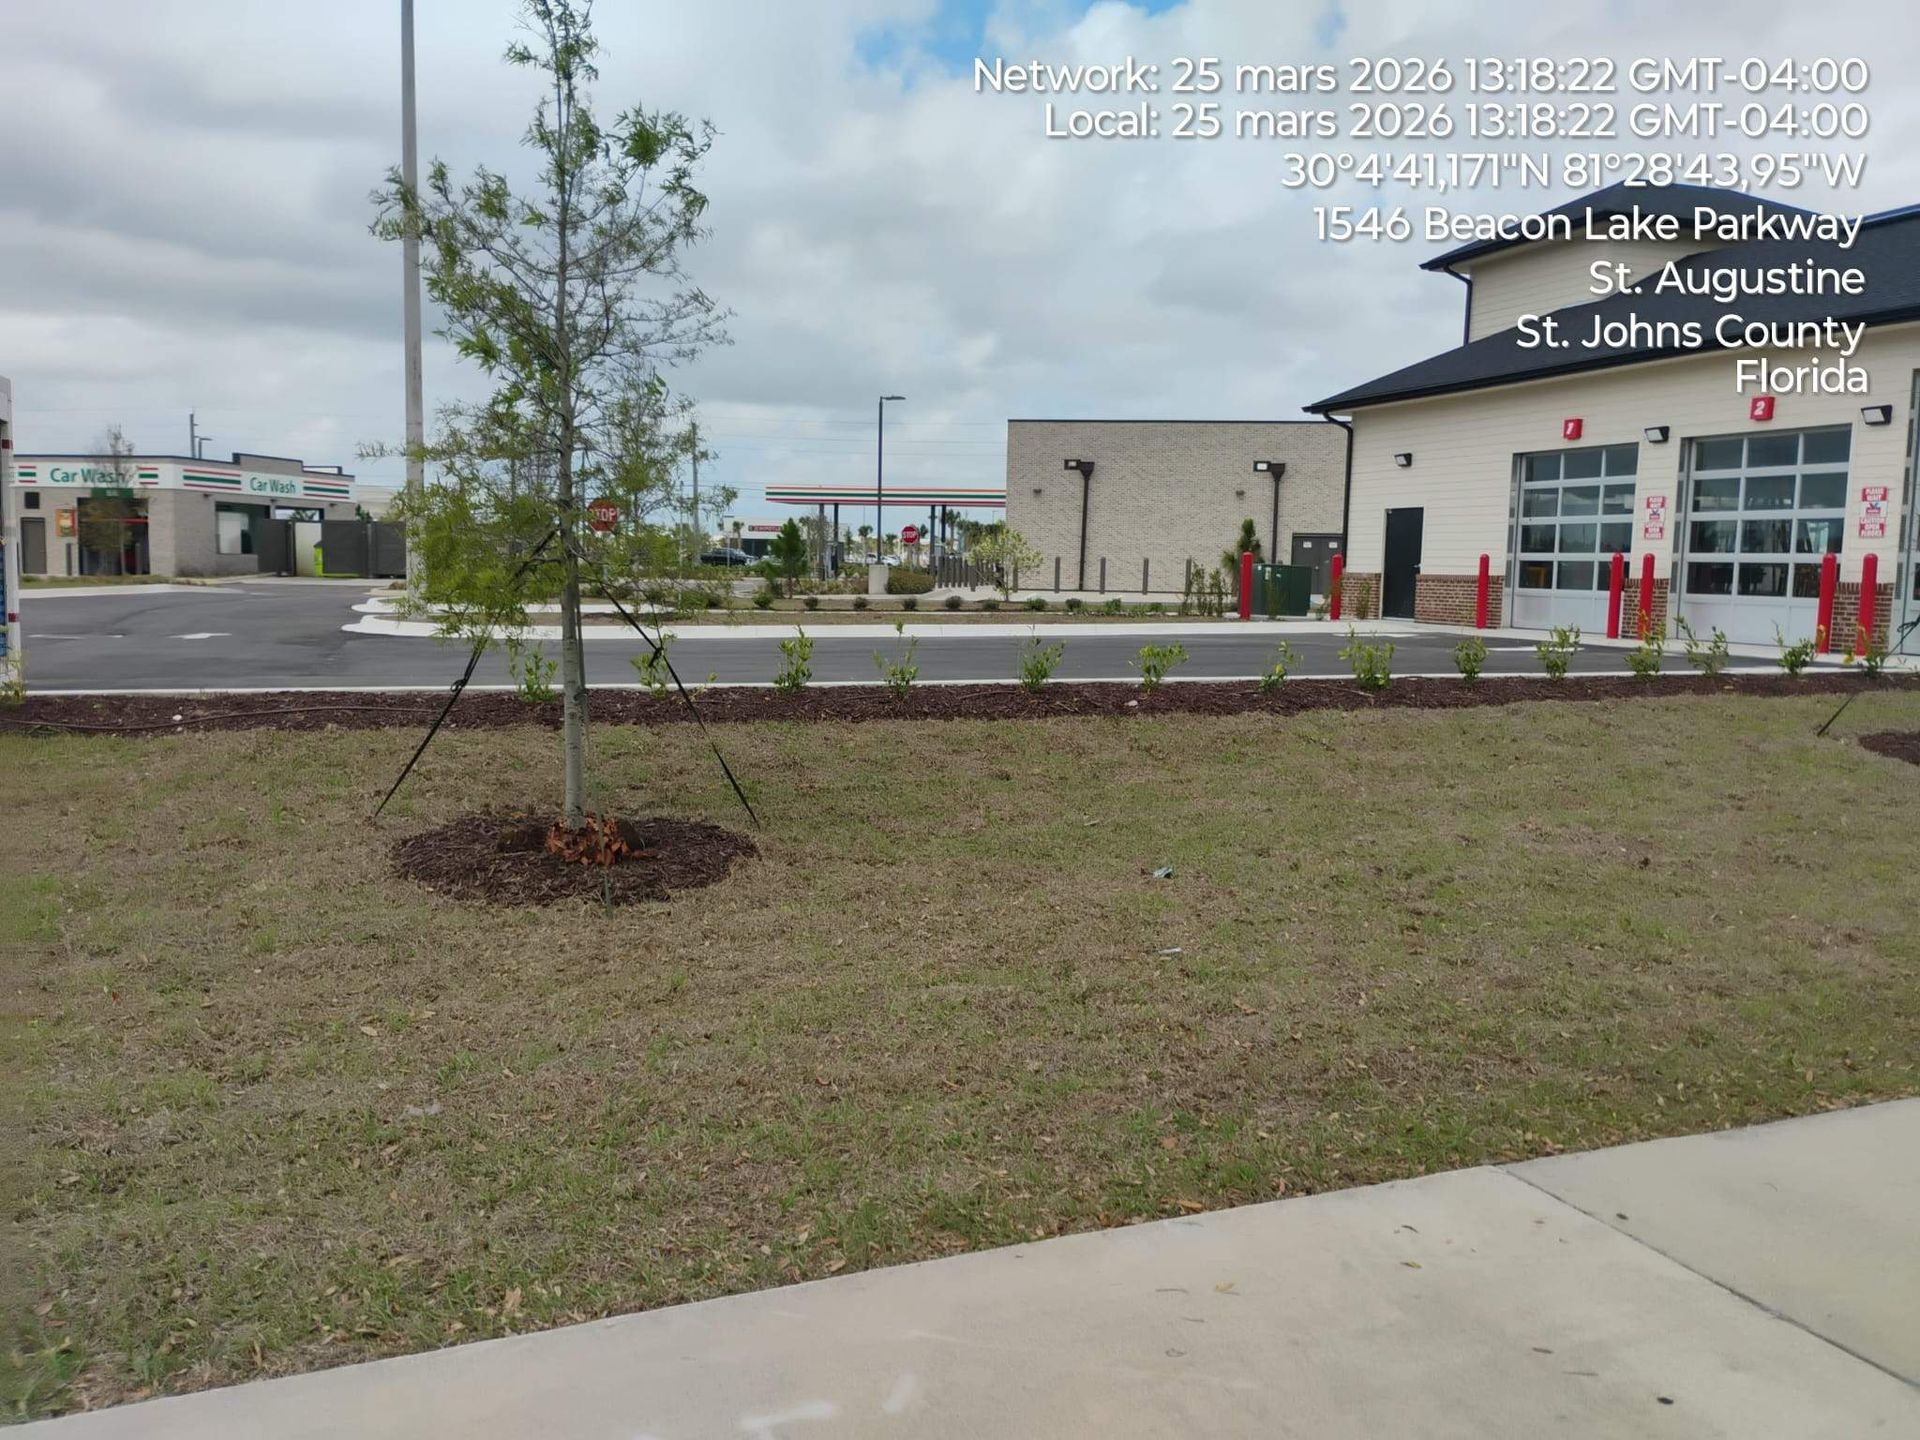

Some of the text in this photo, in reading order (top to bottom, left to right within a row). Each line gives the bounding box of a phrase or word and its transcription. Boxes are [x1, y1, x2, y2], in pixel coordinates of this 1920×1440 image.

[1753, 400, 1766, 416] 2
[1565, 421, 1575, 436] 1
[49, 467, 127, 484] Car Wash
[250, 476, 296, 494] Car Wash
[901, 530, 916, 539] STOP
